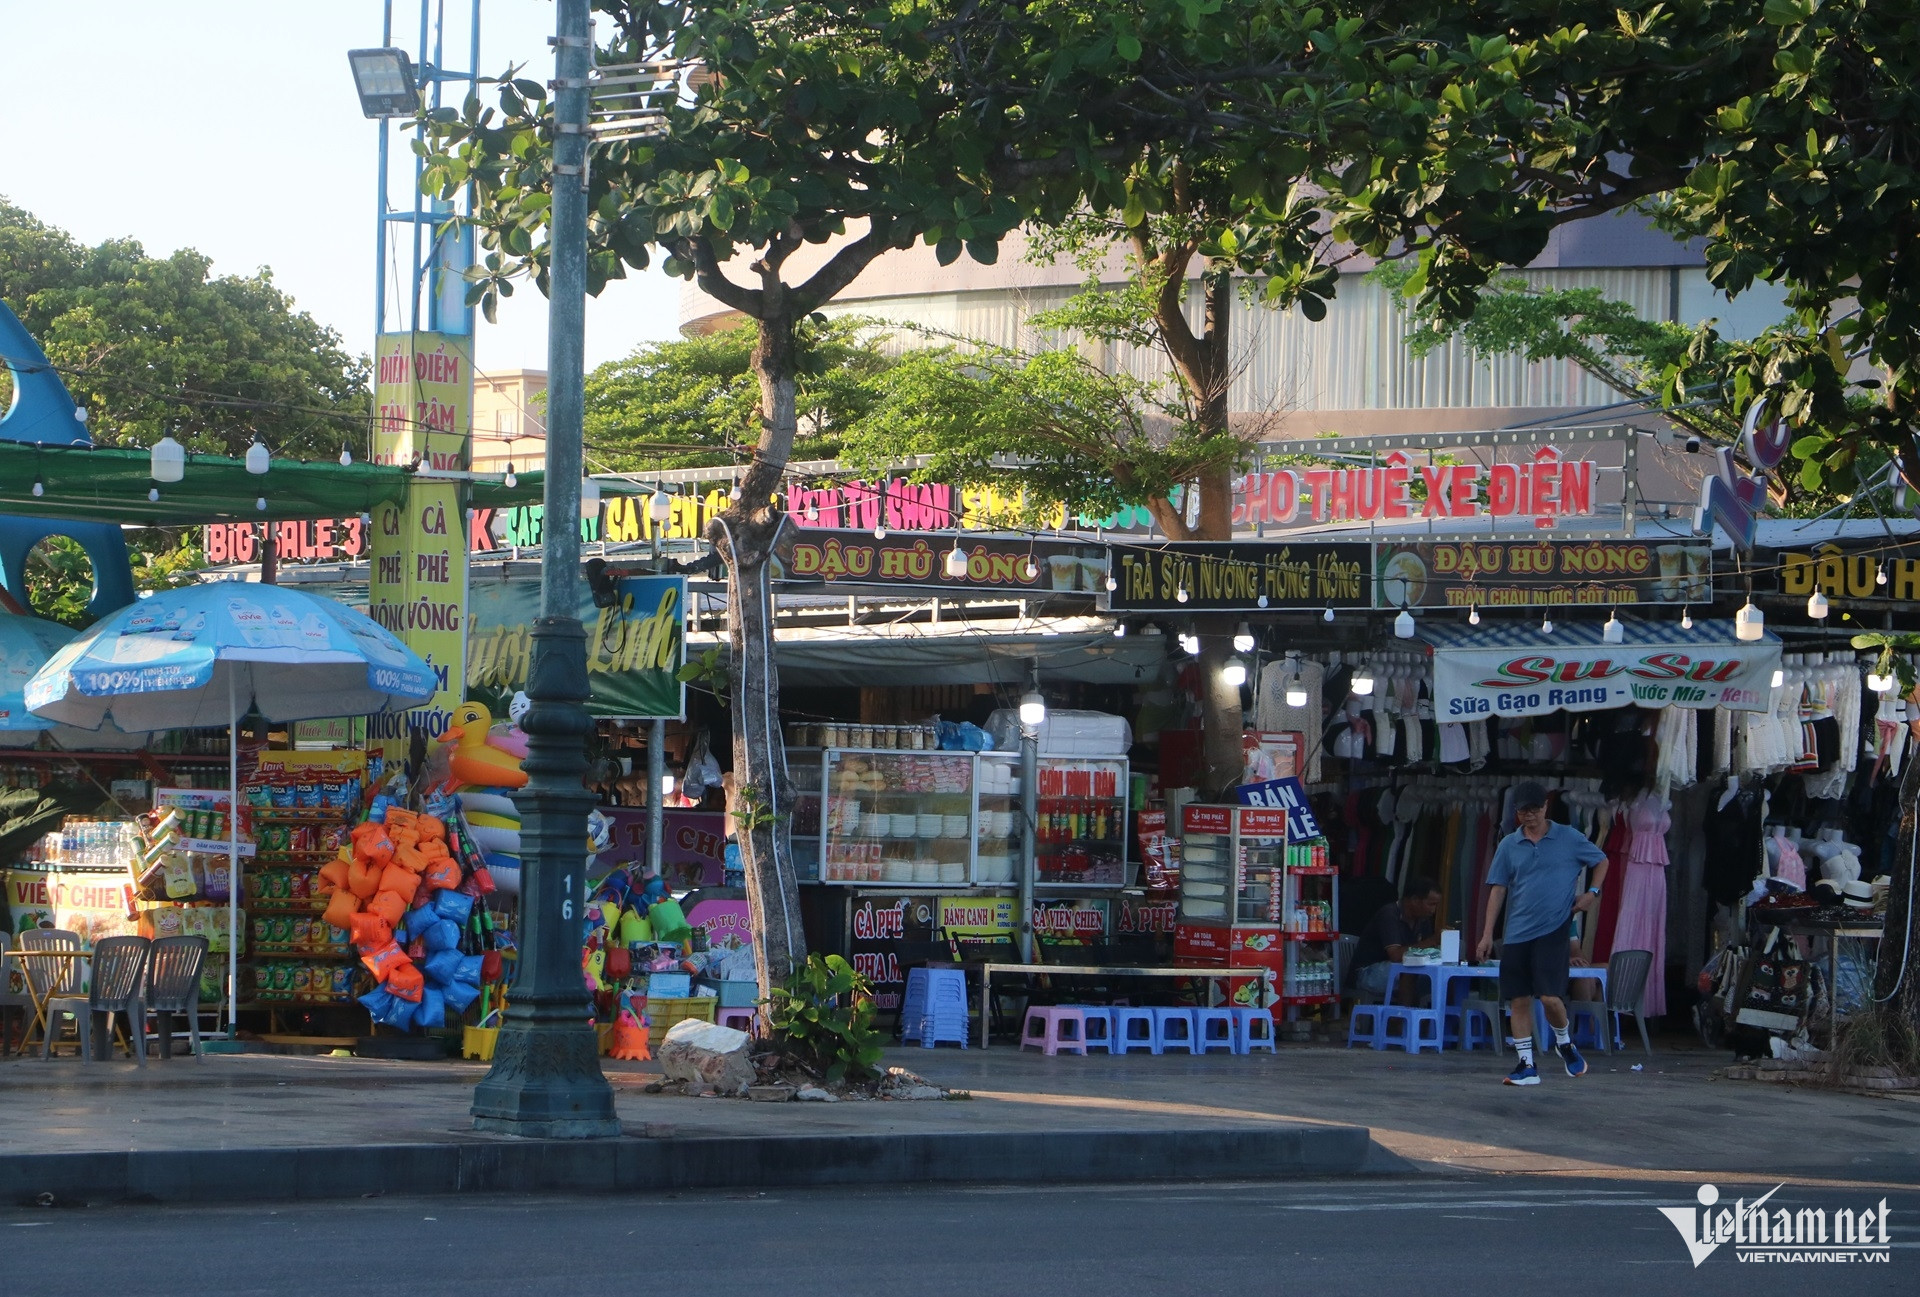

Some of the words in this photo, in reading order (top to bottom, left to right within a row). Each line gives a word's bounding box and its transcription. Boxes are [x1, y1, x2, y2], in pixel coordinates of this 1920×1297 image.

[415, 342, 459, 384] ĐIỂM
[417, 397, 456, 433] TÂM
[1304, 451, 1413, 521] THUÊ
[1420, 465, 1482, 517] XE
[421, 501, 447, 535] CÀ
[506, 505, 545, 547] CAF
[417, 549, 450, 583] PHÊ
[793, 538, 874, 582] ĐẬU
[879, 539, 933, 581] HỦ
[1122, 552, 1154, 600] TRÀ
[1200, 549, 1258, 600] NƯỚNG
[1264, 545, 1310, 599] HỒNG
[1316, 550, 1361, 599] KÔNG
[1433, 541, 1503, 580] ĐẬU
[1508, 539, 1555, 575] HỦ
[1562, 540, 1650, 574] NÓNG
[1489, 583, 1529, 606] CHÂU
[408, 597, 459, 631] VÕNG
[89, 670, 141, 691] 100%
[376, 669, 401, 688] 100%
[1450, 695, 1490, 716] Sữa
[1498, 692, 1541, 713] Gạo
[1549, 686, 1608, 707] Rang
[1630, 682, 1668, 702] Nước
[296, 784, 313, 792] POCA
[323, 783, 340, 792] POCA
[854, 901, 875, 939] CÀ
[876, 901, 904, 939] PHÊ
[944, 904, 965, 926] BÁNH
[968, 908, 988, 926] CANH
[1033, 904, 1046, 930] CÁ
[1049, 904, 1072, 930] VIÊN
[1138, 902, 1176, 932] PHÊ
